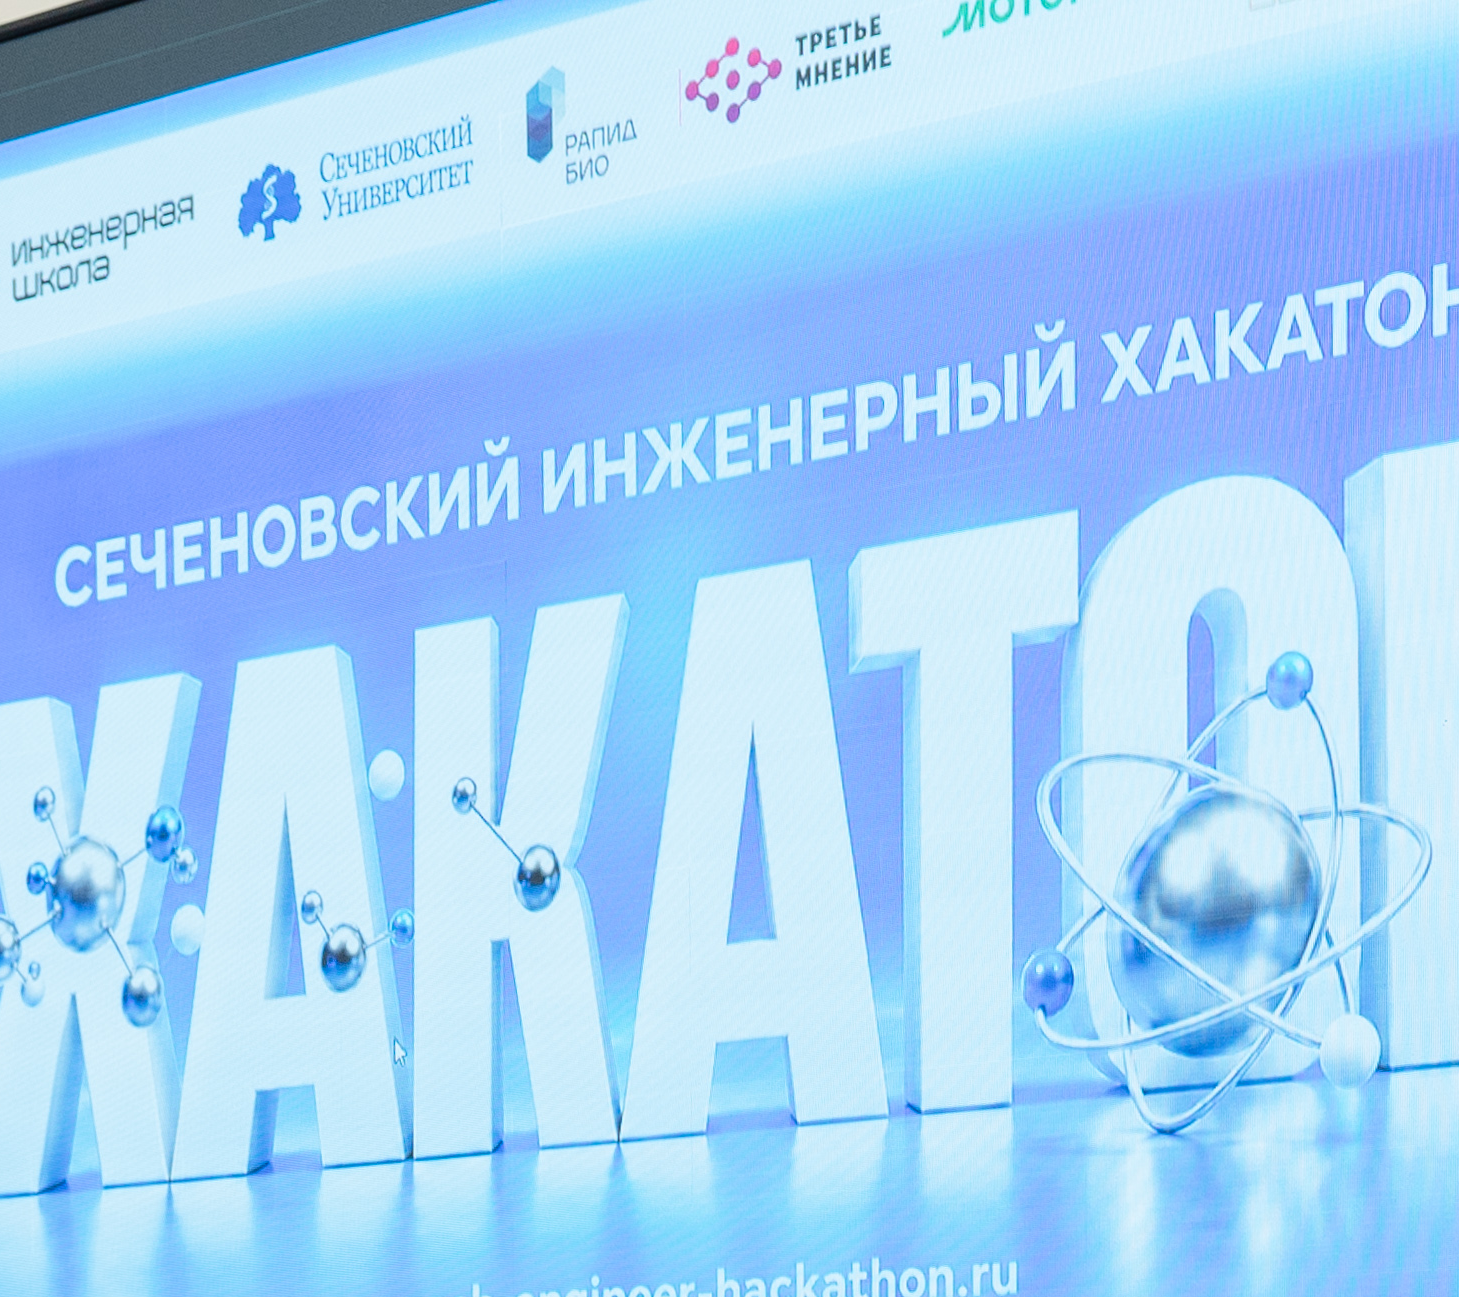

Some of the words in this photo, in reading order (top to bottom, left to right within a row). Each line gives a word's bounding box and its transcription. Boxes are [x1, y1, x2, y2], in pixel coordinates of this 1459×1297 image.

[795, 14, 881, 56] ТРЕТЬЕ
[795, 44, 892, 91] МНЕНИЕ
[319, 113, 473, 183] СЕЧЕНОВСКИЙ
[565, 118, 637, 157] РАПИД
[321, 159, 474, 221] УНИВЕРСИТЕТ
[565, 154, 610, 186] БИО
[11, 194, 194, 251] инженерная
[12, 254, 111, 303] школа
[54, 435, 520, 608] СЕЧЕНОВСКИЙ
[542, 318, 1077, 515] ИНЖЕНЕРНЫЙ
